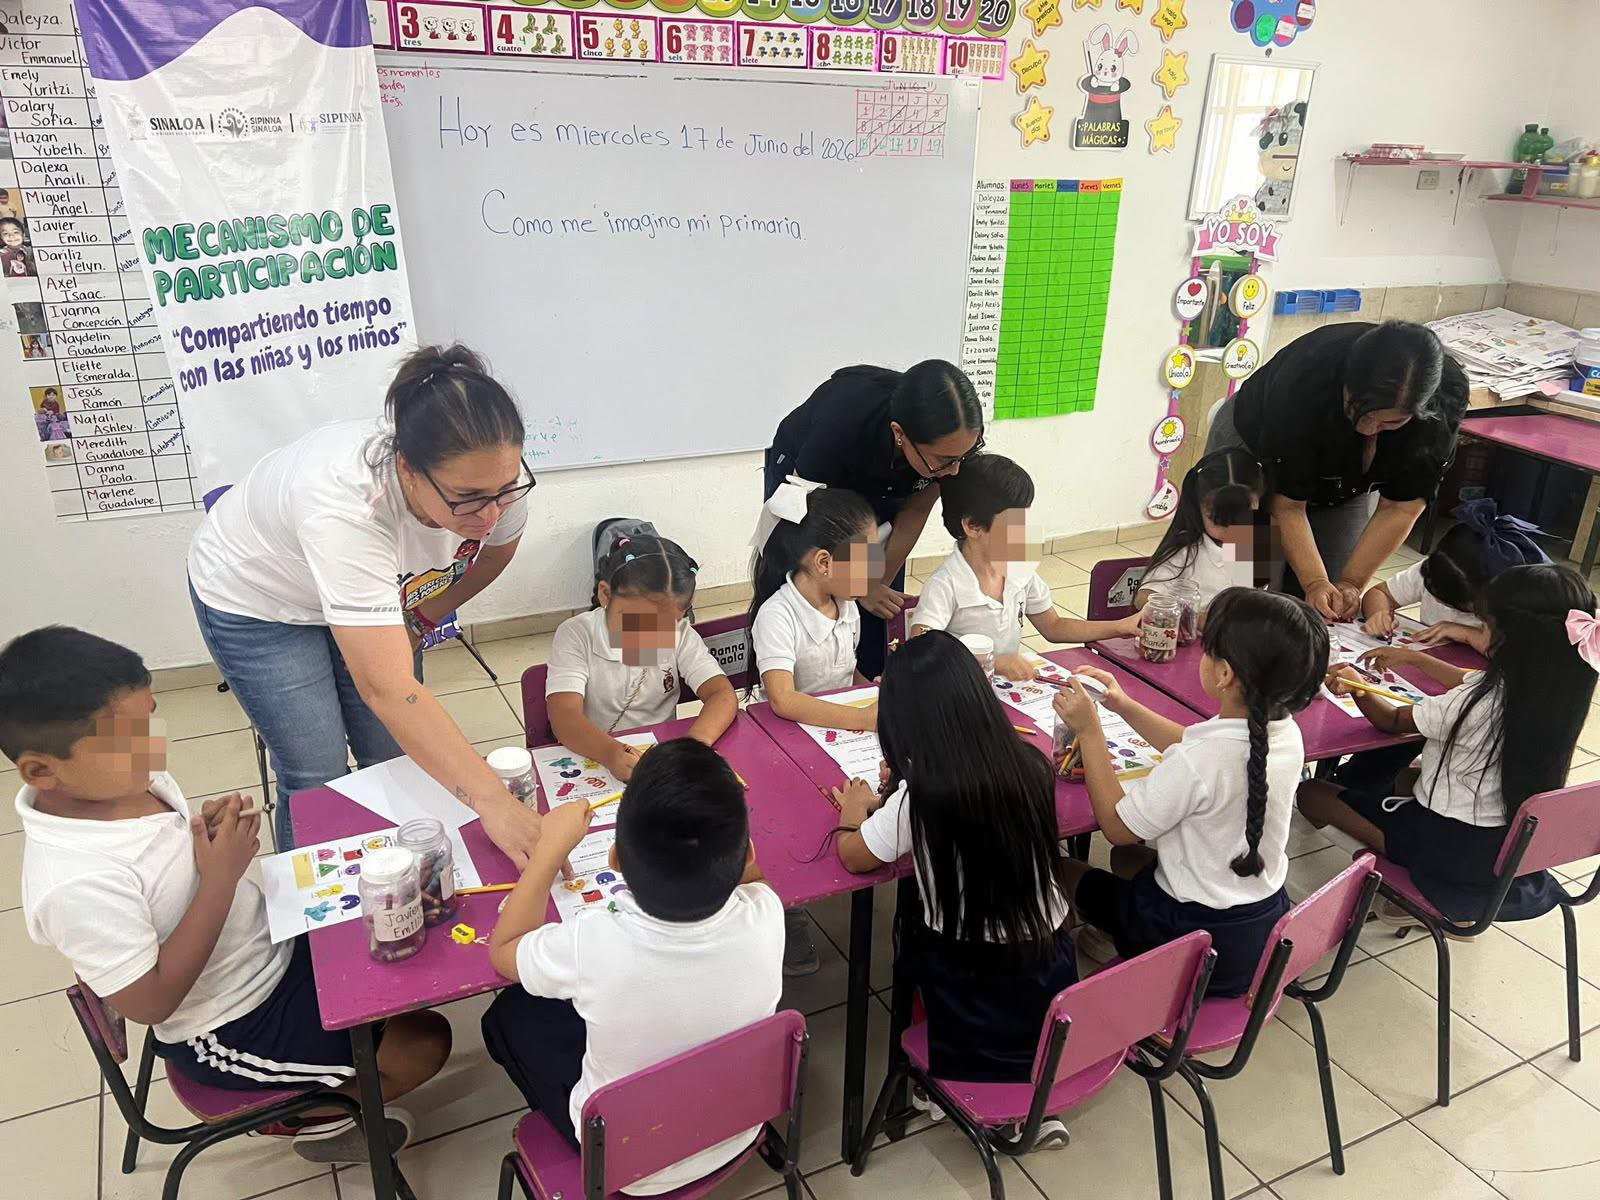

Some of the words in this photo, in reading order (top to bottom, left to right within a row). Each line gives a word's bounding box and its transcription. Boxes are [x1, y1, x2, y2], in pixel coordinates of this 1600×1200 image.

[906, 0, 935, 19] 18
[945, 0, 973, 20] 19
[979, 0, 1011, 26] 20
[400, 6, 420, 39] 3
[496, 14, 515, 44] 4
[404, 38, 422, 46] tres
[582, 20, 600, 50] 5
[666, 25, 682, 54] 6
[496, 44, 522, 53] cuatro
[743, 29, 756, 56] 7
[817, 33, 831, 60] 8
[583, 49, 602, 58] cinco
[884, 37, 897, 64] 9
[949, 42, 968, 68] 10
[668, 54, 684, 62] seis
[742, 56, 758, 64] siete
[2, 69, 38, 82] Emely
[23, 81, 74, 97] Yuritzi.
[864, 93, 870, 102] L
[880, 94, 887, 102] M
[898, 94, 905, 102] M
[914, 96, 922, 104] J
[8, 100, 55, 117] Dalary
[150, 117, 205, 131] SINALOA
[250, 116, 282, 124] SIPINNA
[320, 112, 364, 124] SIPINNA
[251, 125, 283, 133] SINALOA
[440, 95, 492, 149] Hoy
[510, 122, 542, 142] es
[680, 124, 709, 151] 17
[716, 126, 734, 149] de
[744, 134, 788, 156] Junio
[793, 130, 815, 156] del
[1084, 122, 1121, 132] PALABRAS
[14, 132, 58, 143] Hazan
[1082, 134, 1118, 145] MÁGICAS
[34, 142, 86, 156] Yubeth.
[890, 138, 904, 152] 17
[906, 138, 918, 152] 18
[926, 138, 941, 152] 19
[22, 160, 69, 174] Dalexa
[44, 174, 91, 187] Anaili.
[26, 190, 70, 206] Miguel
[52, 202, 93, 217] Angel.
[482, 188, 553, 236] Como
[561, 217, 598, 233] me
[605, 213, 681, 239] imagino
[688, 214, 710, 233] mi
[33, 220, 76, 233] Javier
[59, 229, 102, 244] Emilio.
[142, 210, 344, 266] MECANISMO
[352, 204, 396, 239] DE
[1207, 220, 1231, 244] YO
[1236, 224, 1274, 248] SOY
[38, 249, 82, 262] Dariliz
[63, 260, 106, 274] Helyn.
[152, 237, 398, 307] PARTICIPACIÓN
[46, 277, 78, 290] Axel
[62, 290, 106, 302] Isaac.
[1177, 296, 1205, 306] Importante
[51, 304, 100, 318] Ivanna
[1243, 302, 1255, 310] Feliz
[63, 316, 124, 330] Concepción.
[172, 304, 319, 354] “Compartiendo
[324, 297, 392, 326] tiempo
[55, 332, 111, 346] Naydelin
[68, 344, 130, 357] Guadalupe.
[180, 366, 208, 392] con
[214, 357, 246, 382] las
[250, 343, 294, 376] niñas
[298, 343, 312, 370] y
[316, 335, 344, 359] los
[348, 321, 408, 353] niños”
[63, 361, 103, 374] Eliette
[76, 371, 134, 383] Esmeralda.
[68, 386, 103, 400] Jesús
[84, 398, 126, 410] Ramón.
[74, 412, 114, 426] Natali
[94, 422, 137, 435] Ashley.
[76, 437, 128, 450] Meredith
[86, 449, 148, 462] Guadalupe.
[85, 464, 126, 476] Danna
[100, 474, 138, 486] Paola.
[87, 486, 135, 500] Marlene
[98, 496, 158, 512] Guadalupe.
[710, 642, 745, 657] Danna
